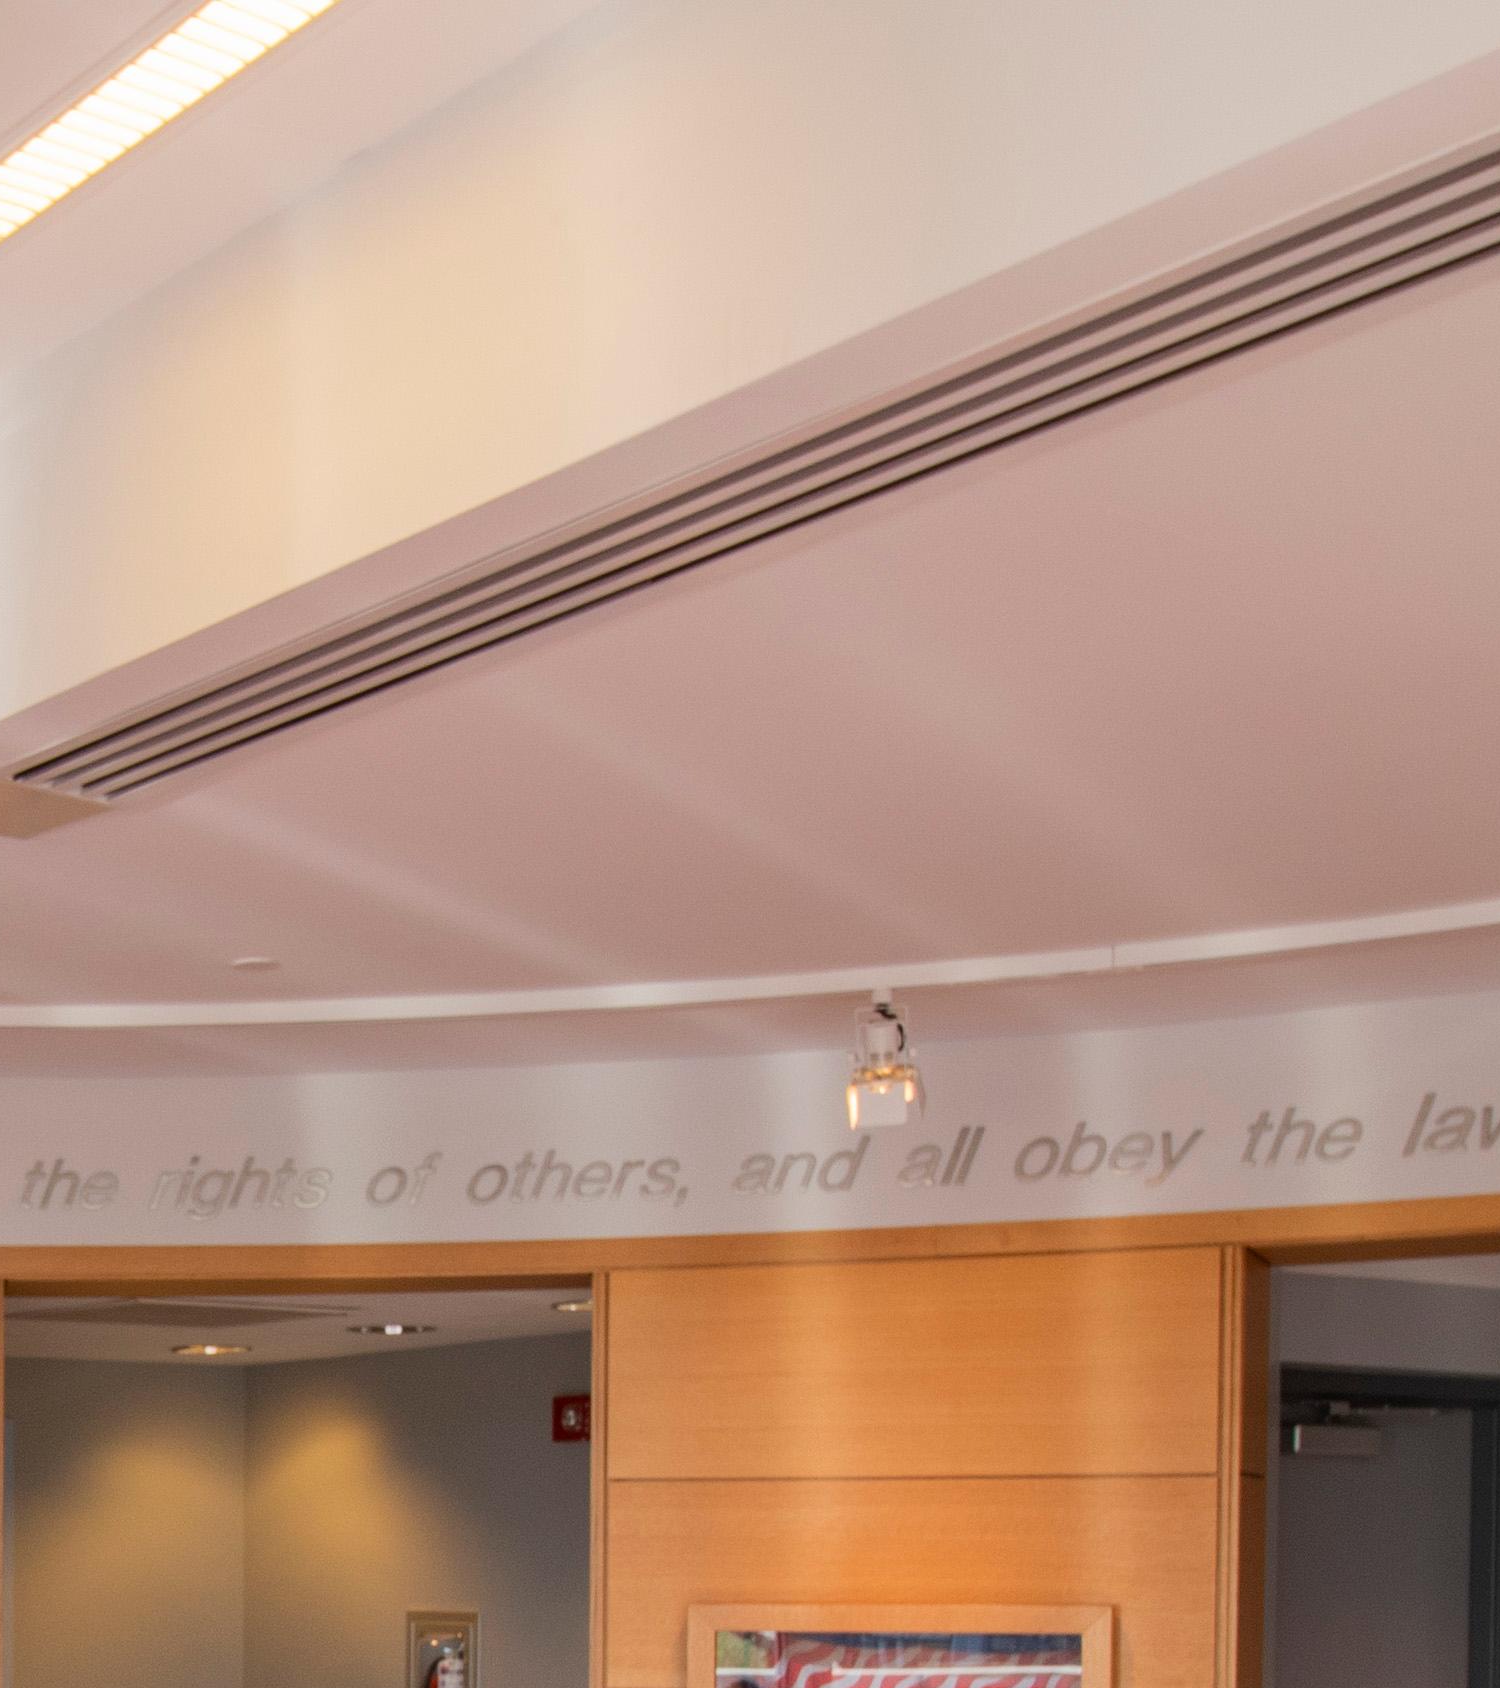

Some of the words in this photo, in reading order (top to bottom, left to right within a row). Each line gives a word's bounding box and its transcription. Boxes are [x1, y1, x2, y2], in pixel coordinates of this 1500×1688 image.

[21, 1158, 120, 1212] the
[149, 1155, 333, 1223] rights
[366, 1151, 443, 1206] of
[468, 1153, 690, 1213] others,
[733, 1135, 870, 1197] and
[898, 1124, 984, 1189] all
[1013, 1122, 1203, 1188] obey
[1243, 1107, 1364, 1167] the
